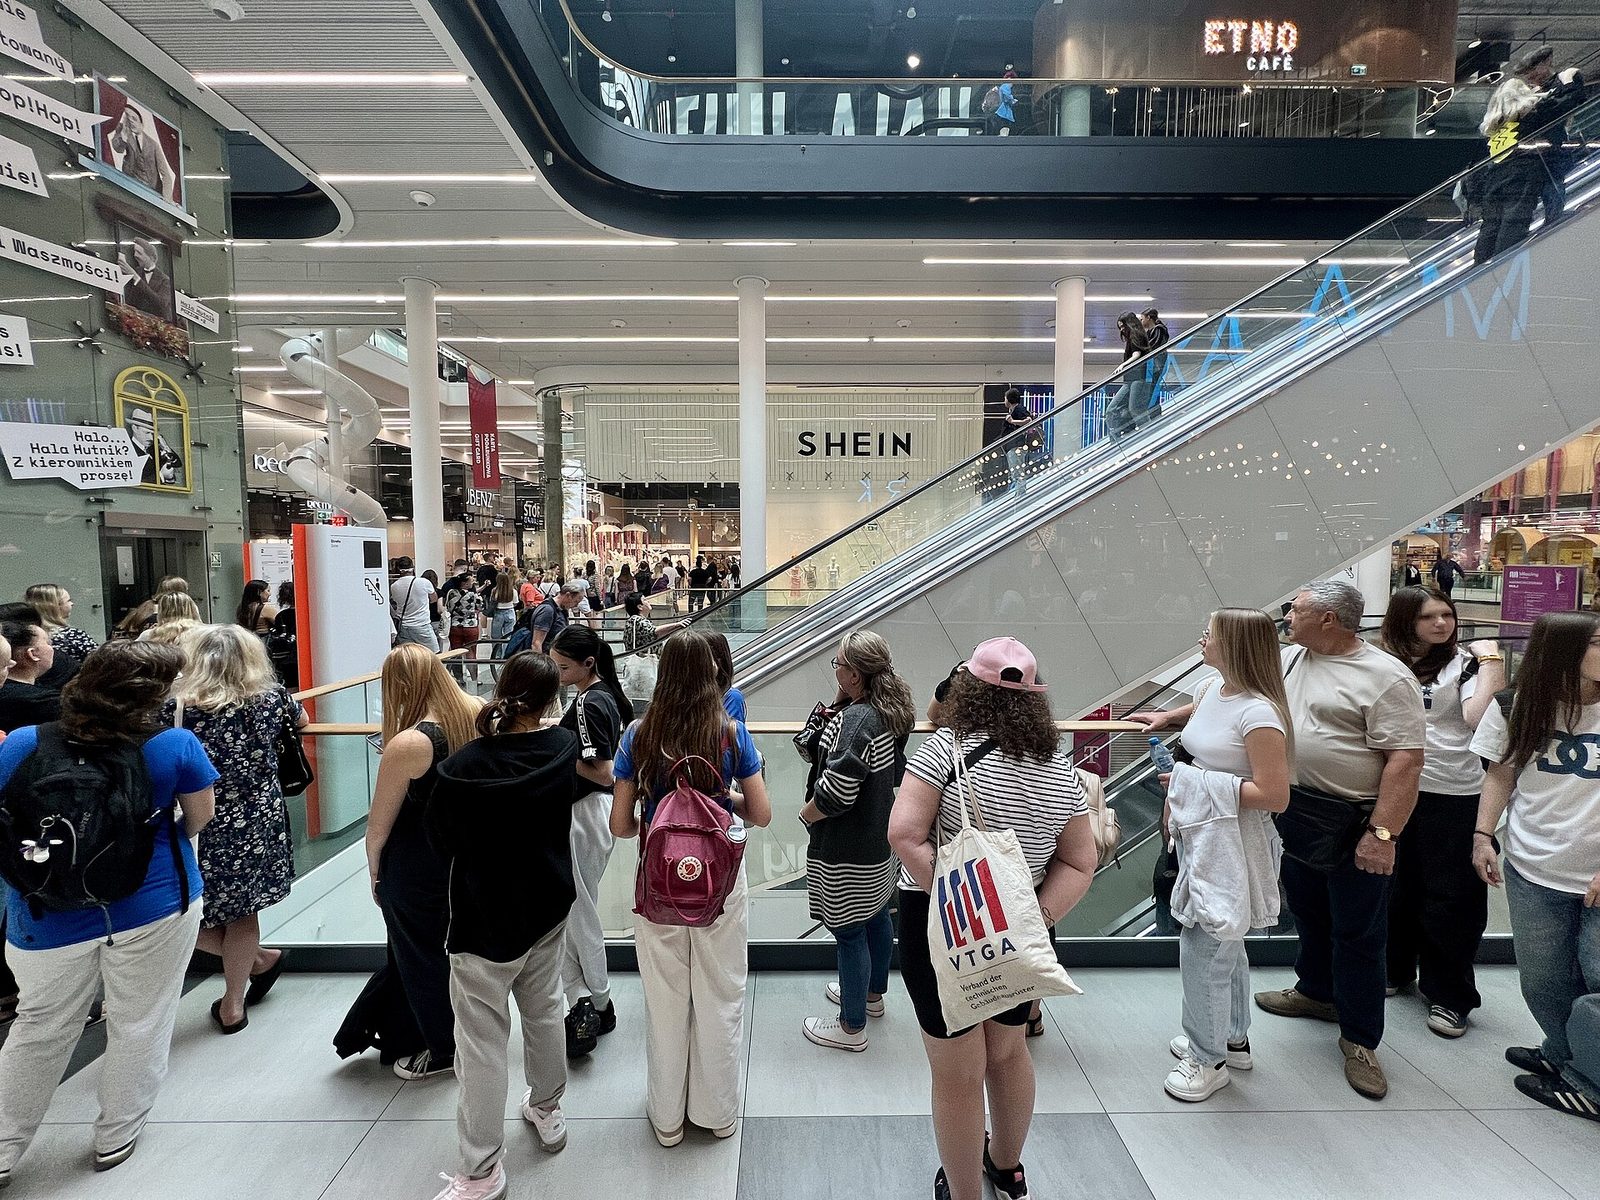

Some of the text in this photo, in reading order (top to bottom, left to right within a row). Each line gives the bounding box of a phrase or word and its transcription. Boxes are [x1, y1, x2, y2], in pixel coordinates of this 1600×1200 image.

[1204, 20, 1298, 54] ETNO
[1246, 53, 1293, 71] CAFÉ
[12, 238, 119, 283] Waszmości!
[30, 443, 129, 456] Hala Hutnik?
[797, 431, 912, 457] SHEIN
[13, 457, 133, 468] Z kierownikiem
[80, 470, 134, 483] proszę!
[949, 937, 1017, 972] VTGA
[960, 974, 1002, 992] Verband der
